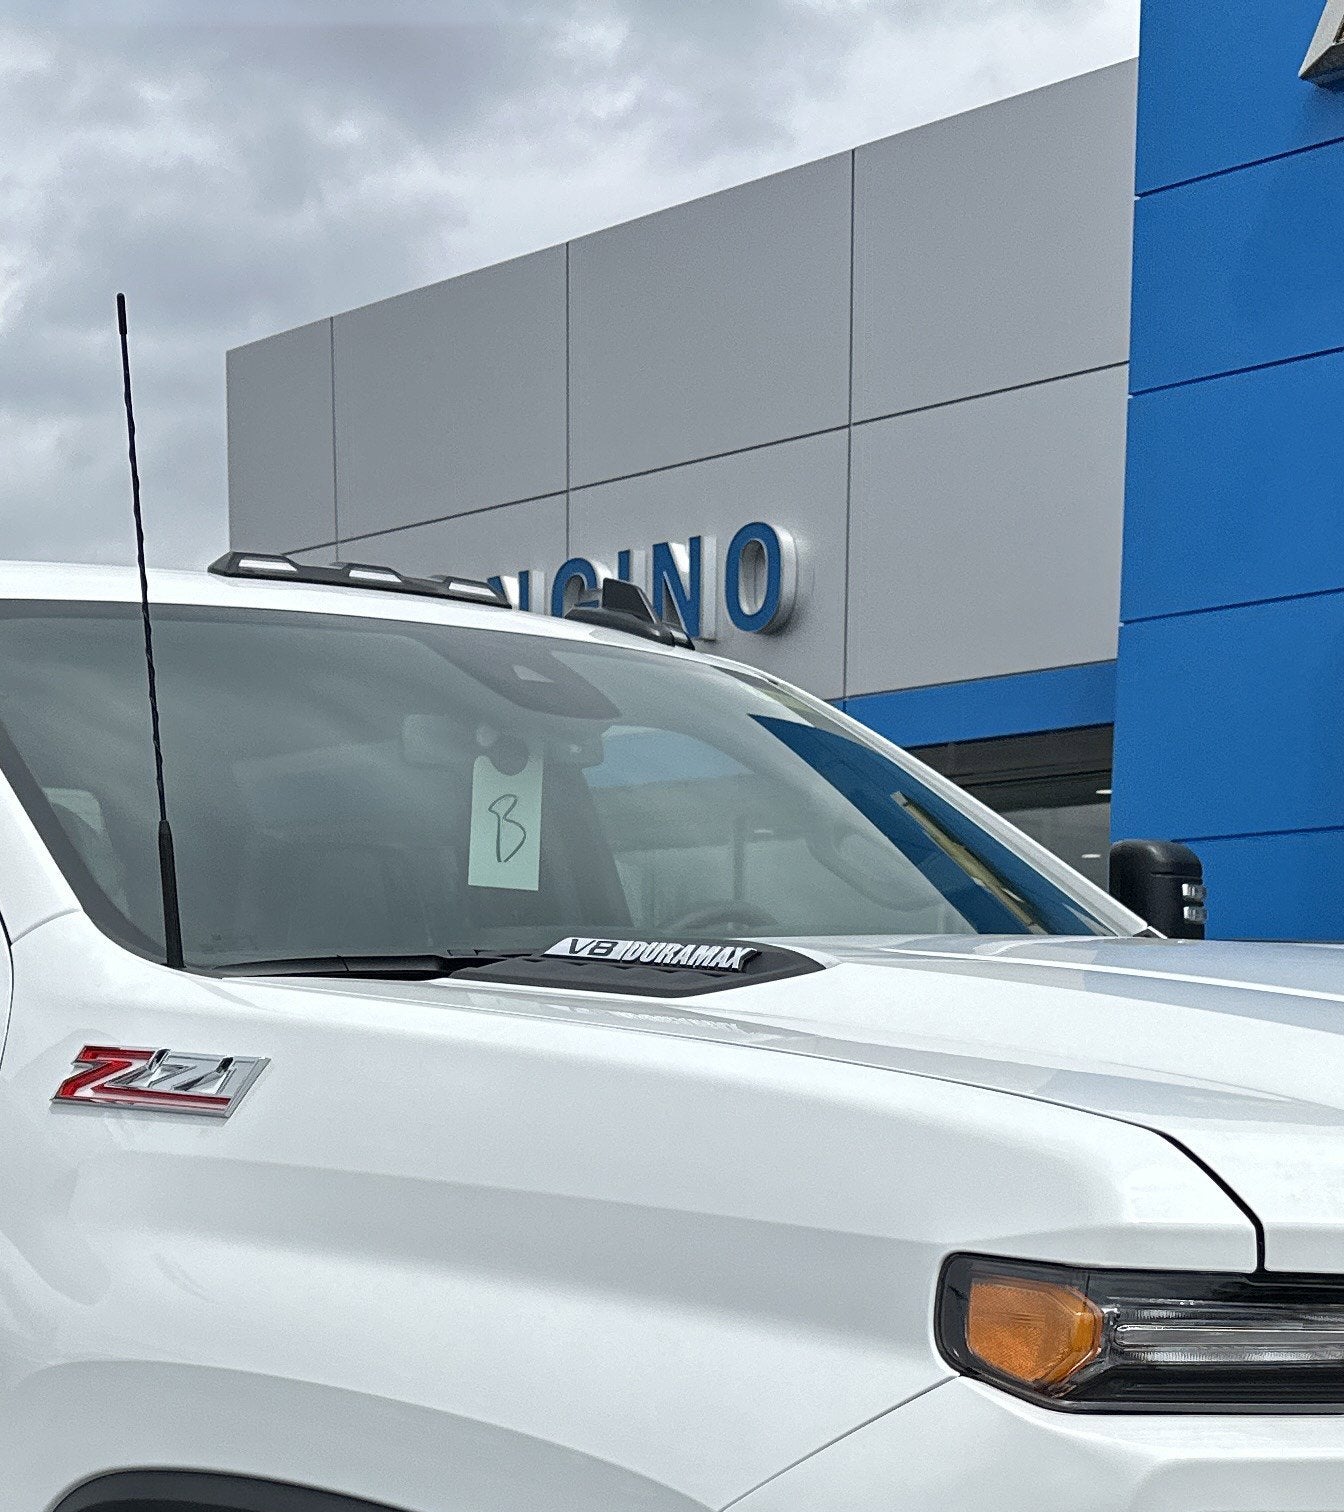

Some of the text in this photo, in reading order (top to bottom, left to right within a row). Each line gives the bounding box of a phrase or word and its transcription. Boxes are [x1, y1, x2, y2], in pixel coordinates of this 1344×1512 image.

[567, 937, 758, 970] V8 DURAMAX
[49, 1043, 272, 1118] Z71
